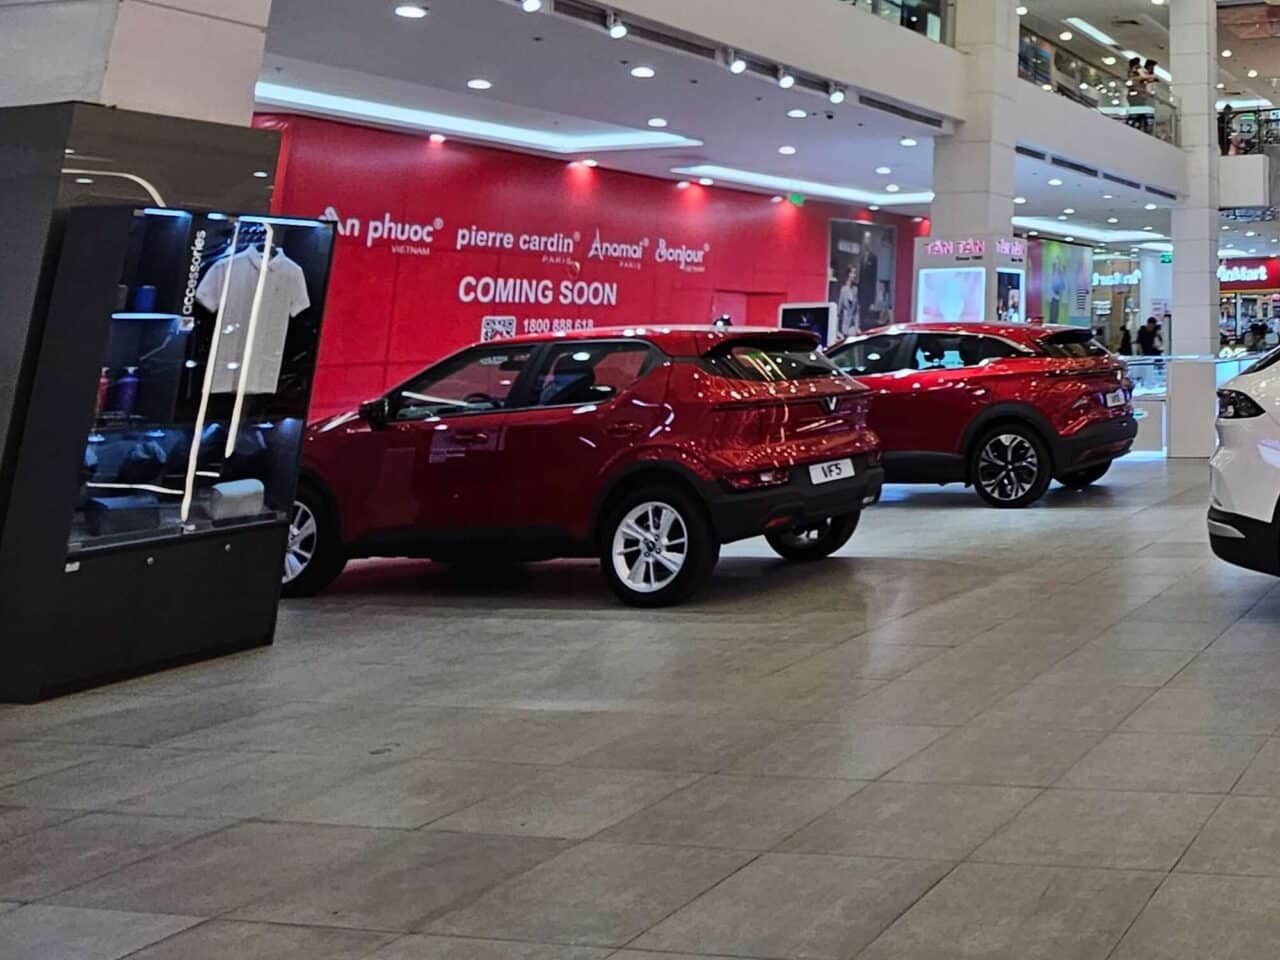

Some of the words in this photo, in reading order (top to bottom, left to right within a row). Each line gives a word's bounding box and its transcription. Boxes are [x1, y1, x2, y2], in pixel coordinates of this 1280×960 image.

[456, 225, 514, 250] pierre
[519, 231, 574, 253] cardin
[182, 229, 207, 315] accessories
[458, 276, 553, 304] COMING
[559, 281, 617, 305] SOON
[523, 318, 550, 334] 1800
